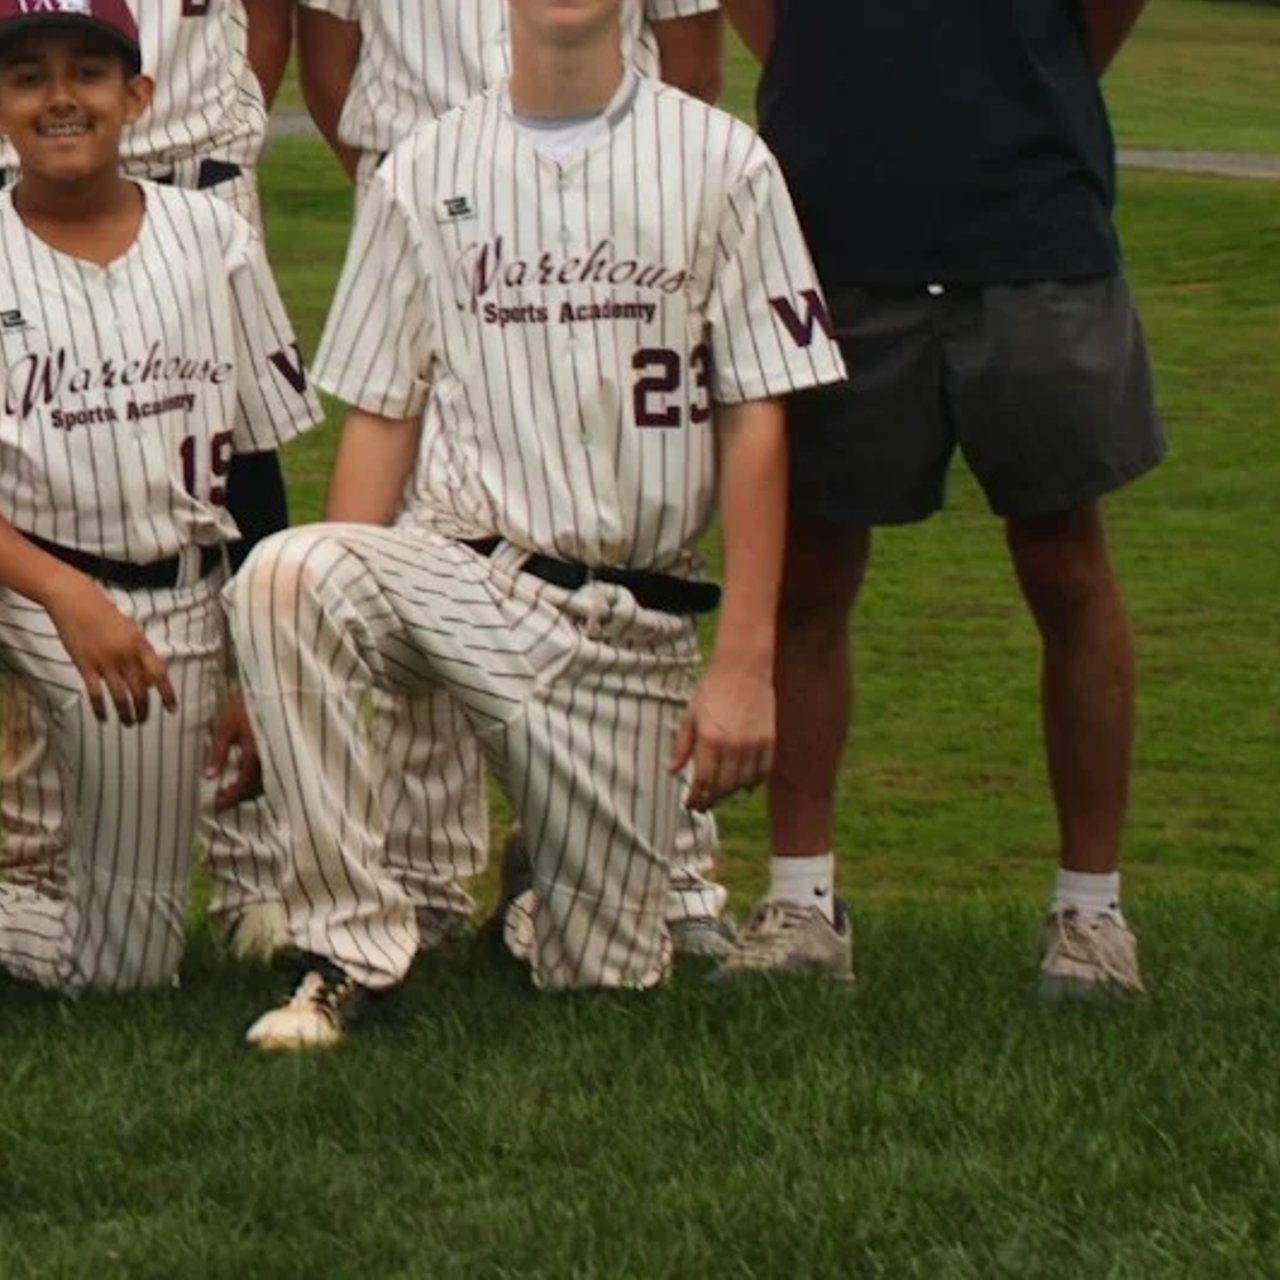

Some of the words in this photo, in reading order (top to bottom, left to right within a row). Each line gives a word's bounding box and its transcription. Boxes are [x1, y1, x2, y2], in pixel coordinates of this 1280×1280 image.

[455, 236, 694, 314] Warehous
[484, 301, 549, 328] Sports
[560, 300, 657, 325] Academy
[768, 289, 838, 349] W
[4, 340, 234, 420] Warehouse
[51, 405, 117, 432] Sports
[126, 393, 197, 420] Acamy
[632, 343, 712, 428] 23
